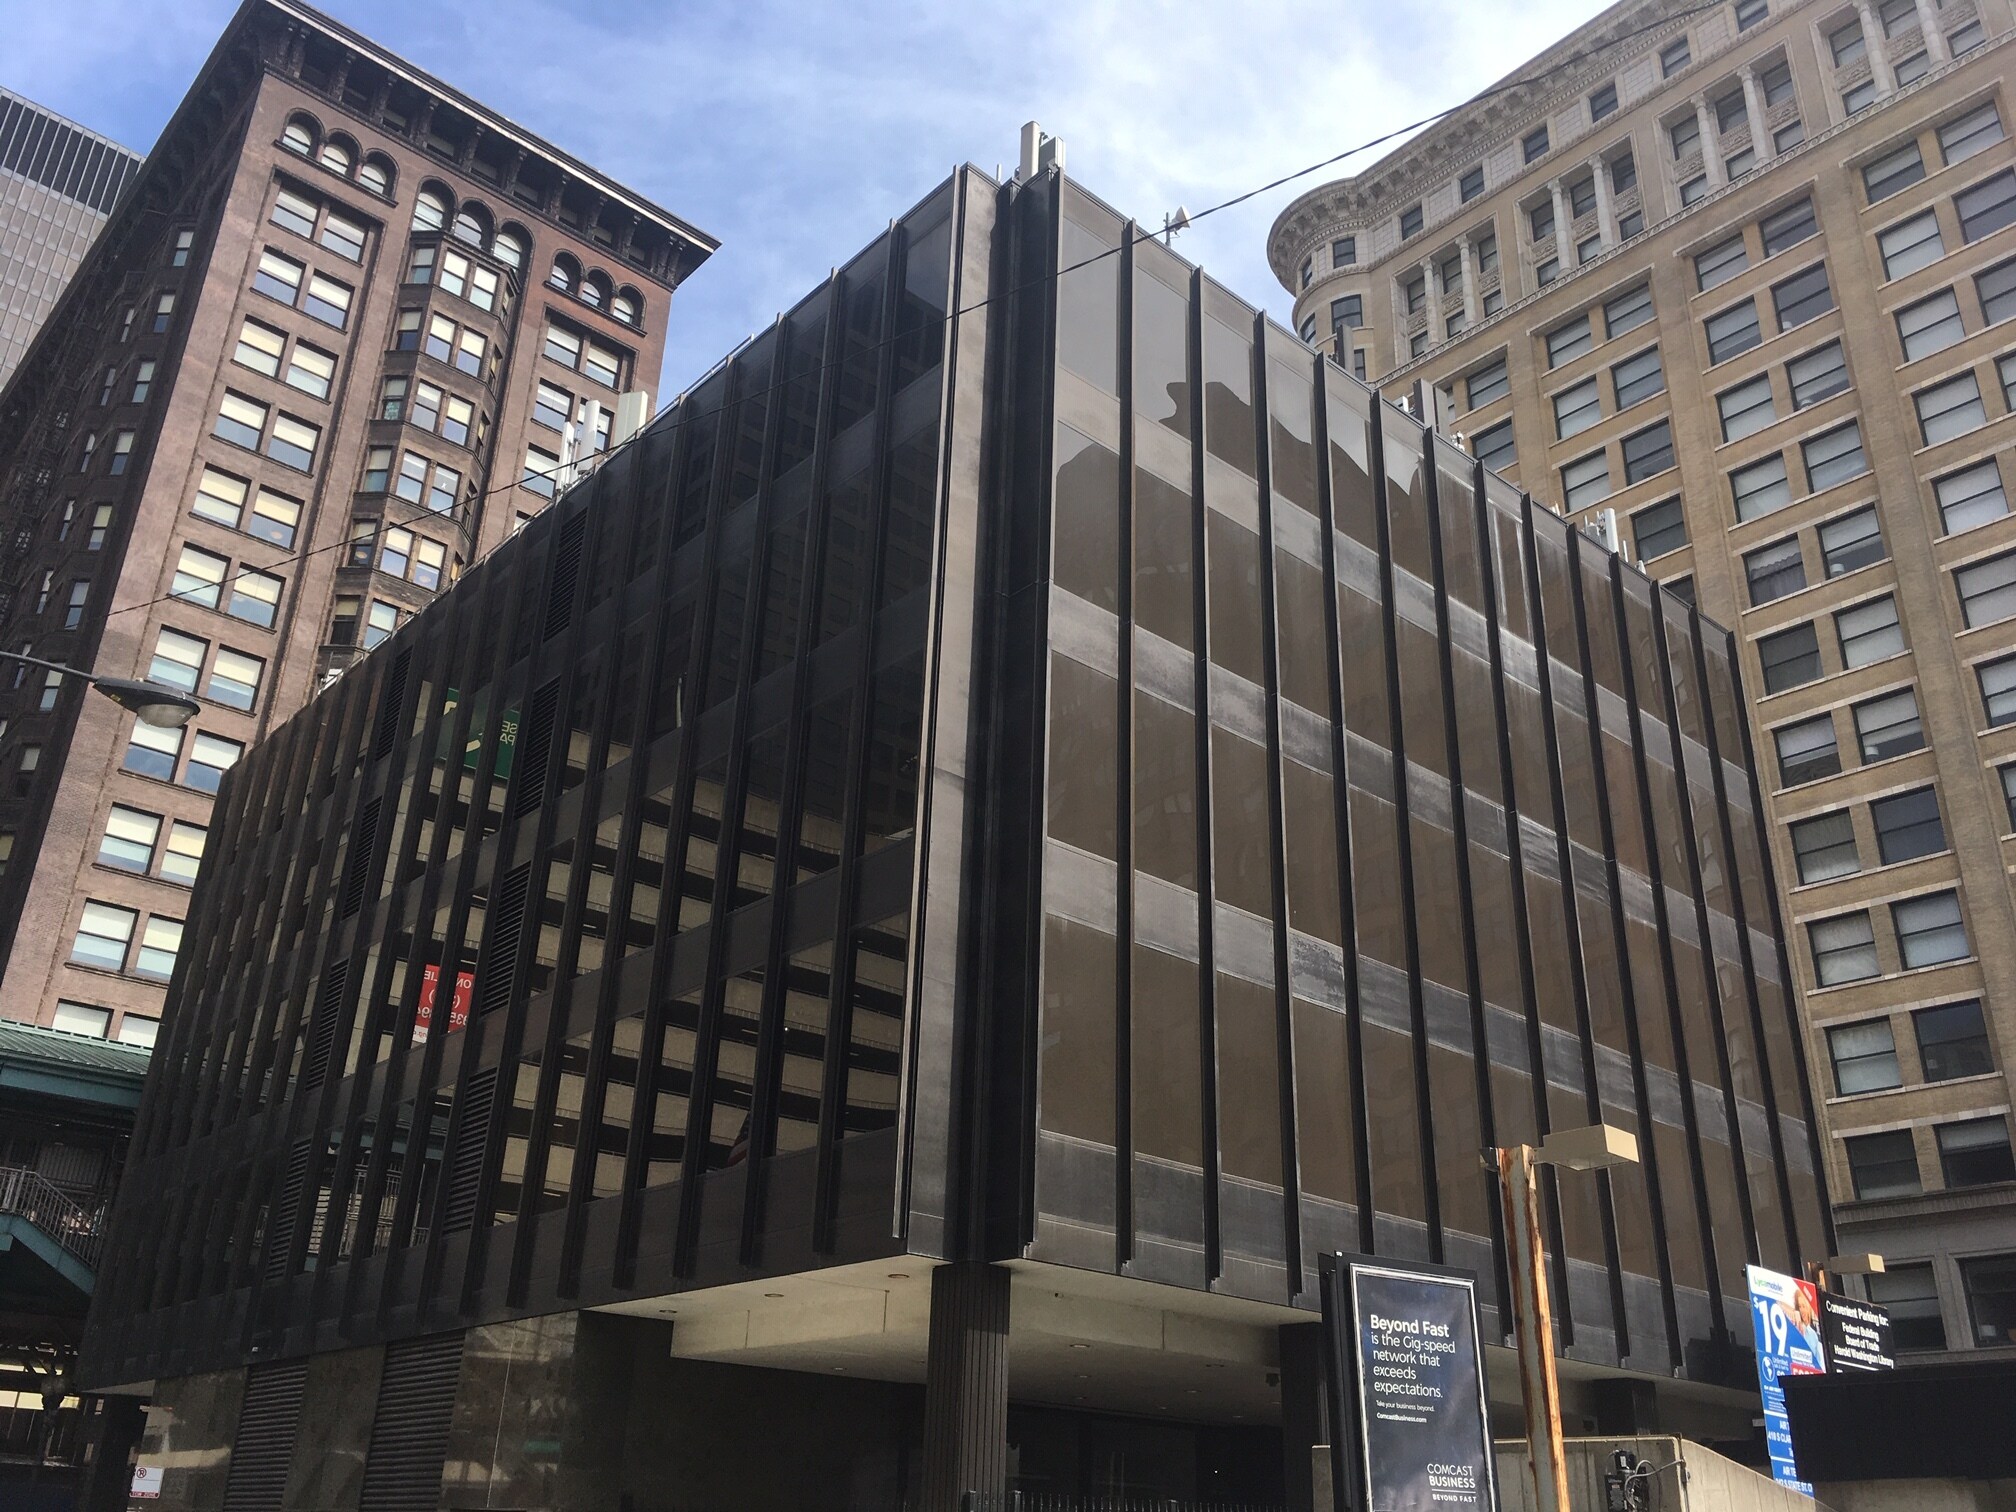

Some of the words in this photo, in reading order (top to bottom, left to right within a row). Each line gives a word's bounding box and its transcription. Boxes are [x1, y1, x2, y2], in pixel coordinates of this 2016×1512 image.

[1826, 1300, 1858, 1319] Convenient
[1858, 1308, 1880, 1327] Parking
[1370, 1314, 1419, 1335] Beyond
[1422, 1321, 1450, 1338] Fast
[1842, 1322, 1860, 1336] Federal
[1860, 1326, 1880, 1343] Building
[1371, 1331, 1379, 1345] is
[1381, 1333, 1401, 1347] the
[1403, 1336, 1456, 1354] Gig-speed
[1845, 1335, 1860, 1348] Board
[1865, 1340, 1880, 1352] Trade
[1373, 1350, 1417, 1365] network
[1419, 1352, 1441, 1367] that
[1834, 1344, 1851, 1358] Harold
[1850, 1348, 1878, 1365] Washington
[1877, 1354, 1894, 1370] Library
[1373, 1365, 1417, 1380] exceeds
[1374, 1381, 1444, 1399] expectations.
[1396, 1402, 1416, 1411] business
[1427, 1463, 1473, 1476] COMCAST
[1429, 1475, 1476, 1489] BUSINESS
[1432, 1493, 1458, 1502] BEYOND
[1459, 1495, 1477, 1503] FAST
